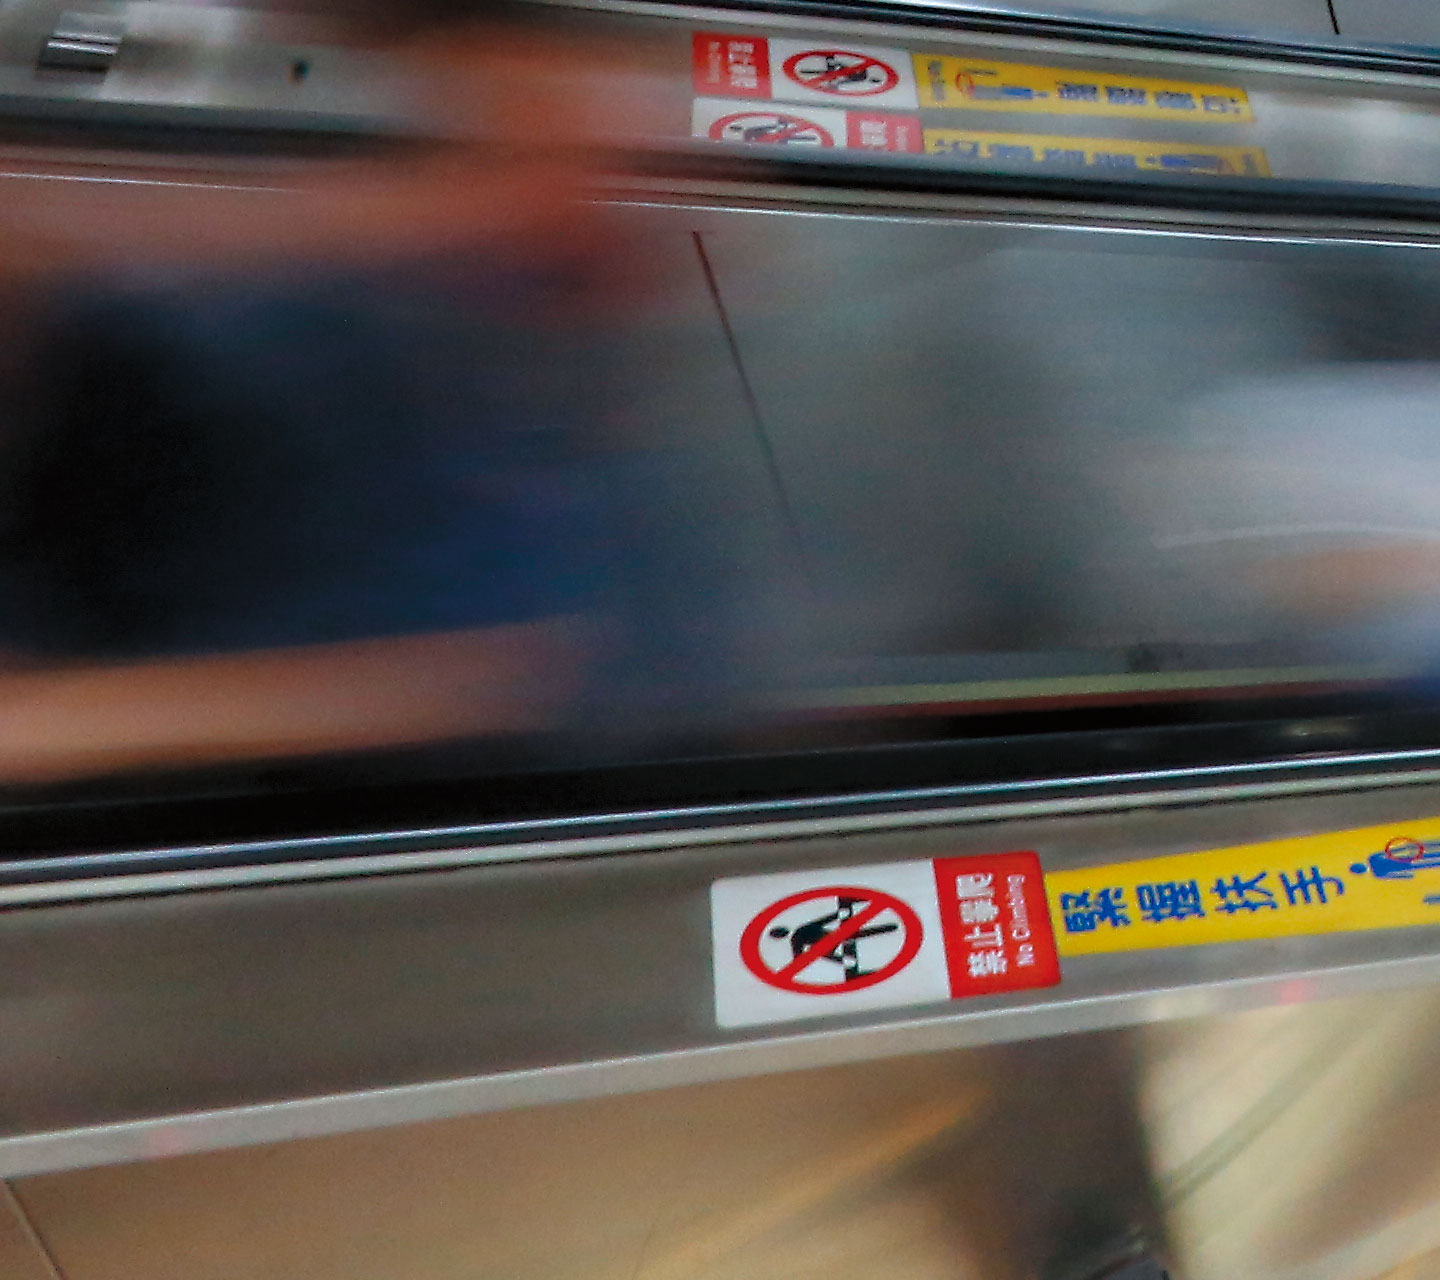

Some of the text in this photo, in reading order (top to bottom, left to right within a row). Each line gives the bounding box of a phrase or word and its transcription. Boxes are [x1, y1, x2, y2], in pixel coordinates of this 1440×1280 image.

[955, 872, 1008, 978] 禁止攀爬
[1060, 865, 1346, 934] 緊握扶手
[1016, 943, 1035, 968] No
